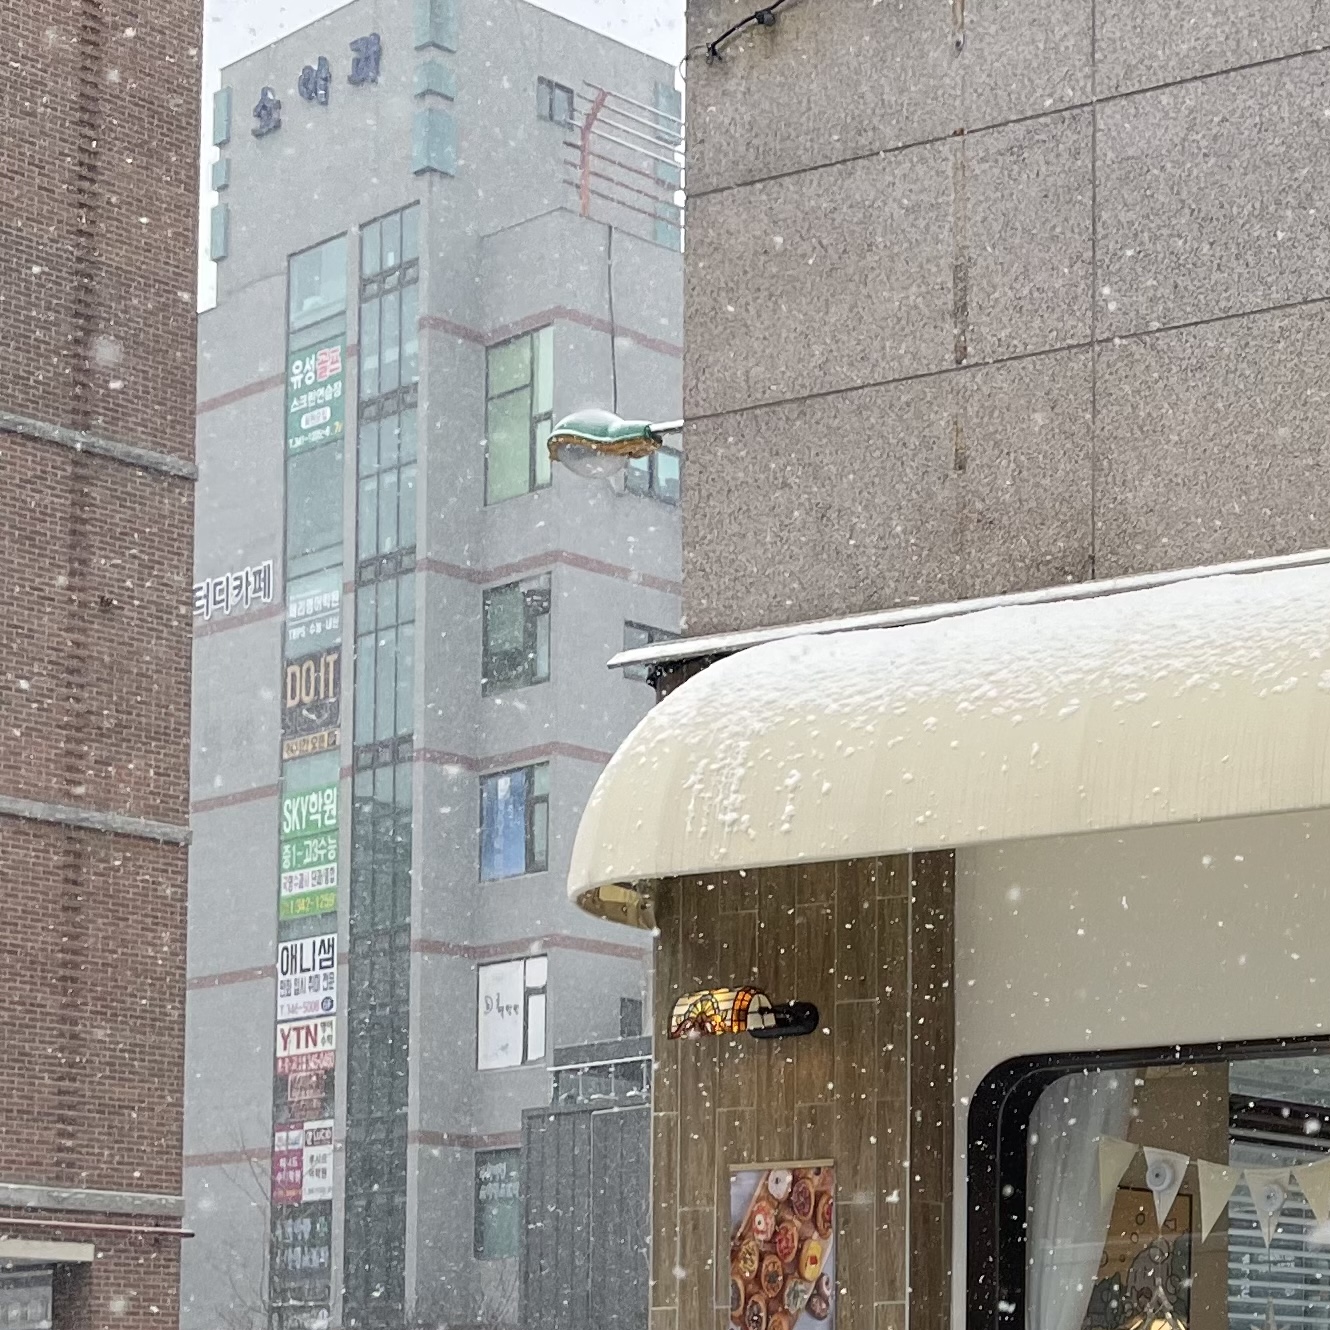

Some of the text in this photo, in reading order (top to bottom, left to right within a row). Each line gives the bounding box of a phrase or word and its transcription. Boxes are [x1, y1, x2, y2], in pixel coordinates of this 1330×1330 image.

[283, 787, 337, 833] SKY학원
[280, 937, 335, 976] 애니샘
[280, 1023, 318, 1051] YTN
